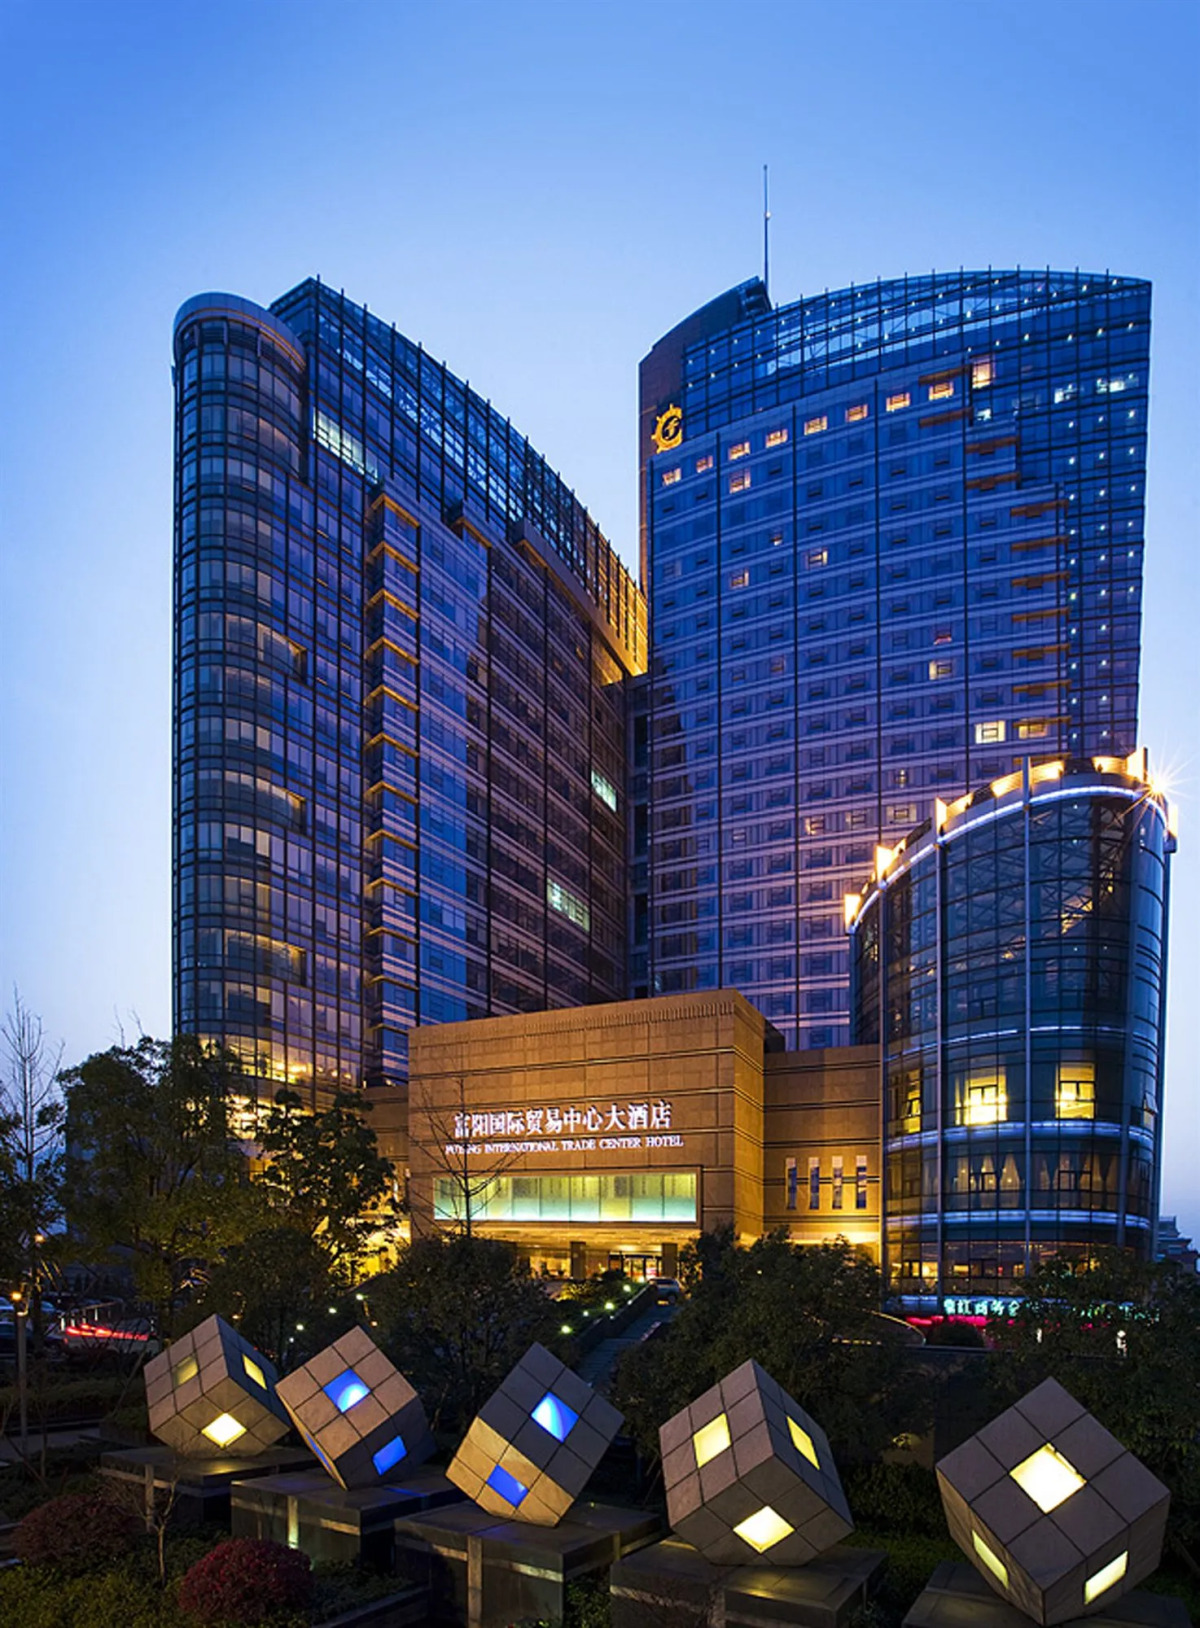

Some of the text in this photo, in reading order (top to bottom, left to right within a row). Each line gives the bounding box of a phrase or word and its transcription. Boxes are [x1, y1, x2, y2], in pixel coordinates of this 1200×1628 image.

[454, 1100, 672, 1138] 富阳国际贸易中心大酒店
[485, 1139, 559, 1153] INTERNATIONAL
[561, 1138, 596, 1151] TRADE
[599, 1136, 642, 1149] CENTER
[645, 1134, 684, 1147] HOTEL
